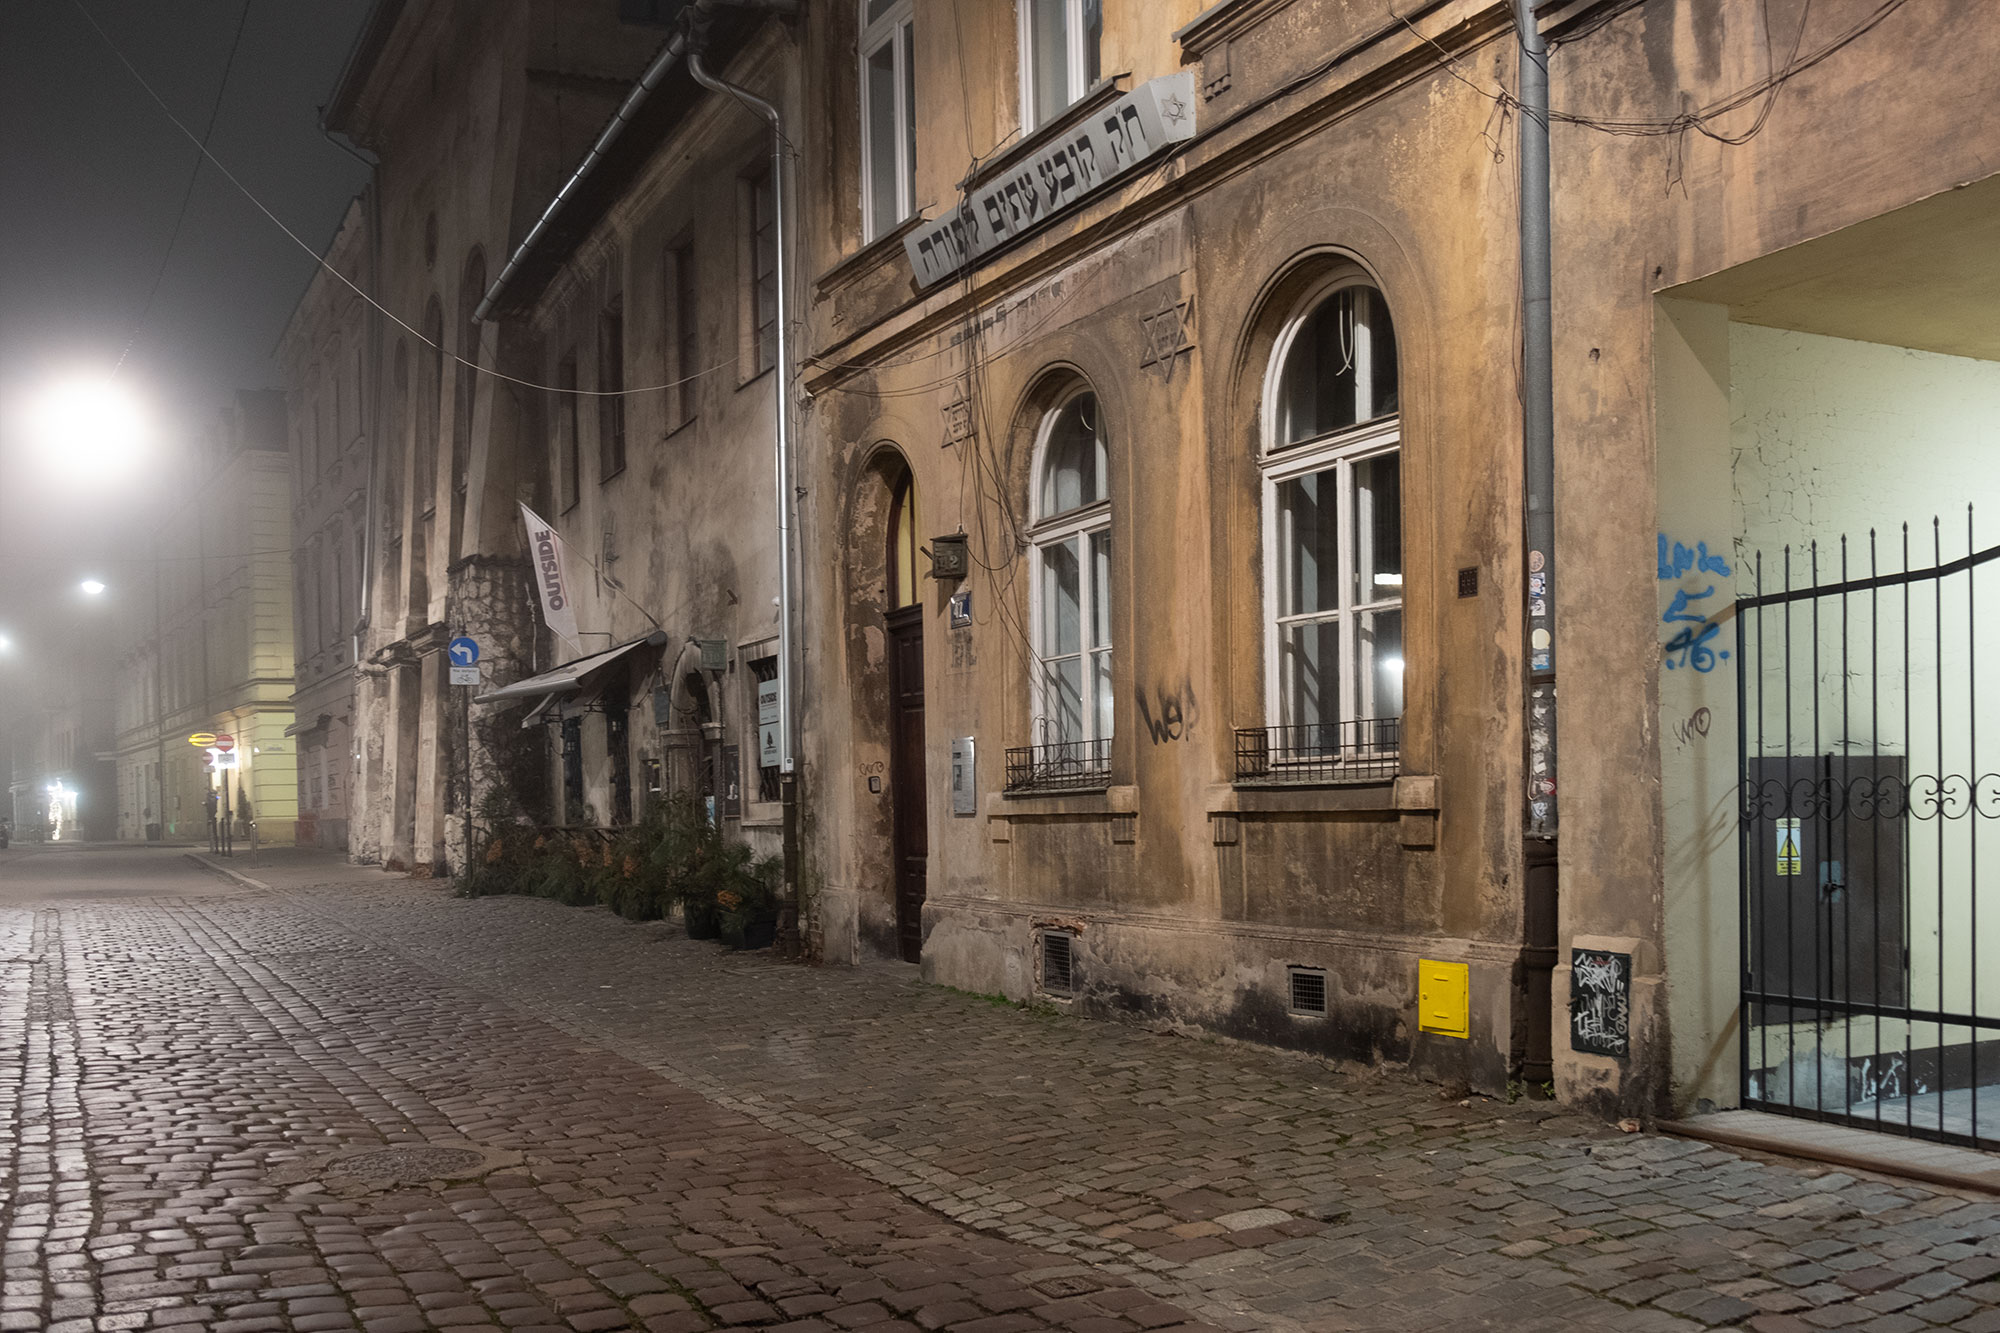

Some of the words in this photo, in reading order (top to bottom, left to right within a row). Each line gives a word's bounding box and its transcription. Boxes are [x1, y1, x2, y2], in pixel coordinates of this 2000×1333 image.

[983, 172, 1038, 234] עתים
[1037, 134, 1095, 206] קובע
[534, 530, 564, 611] OUTSIDE
